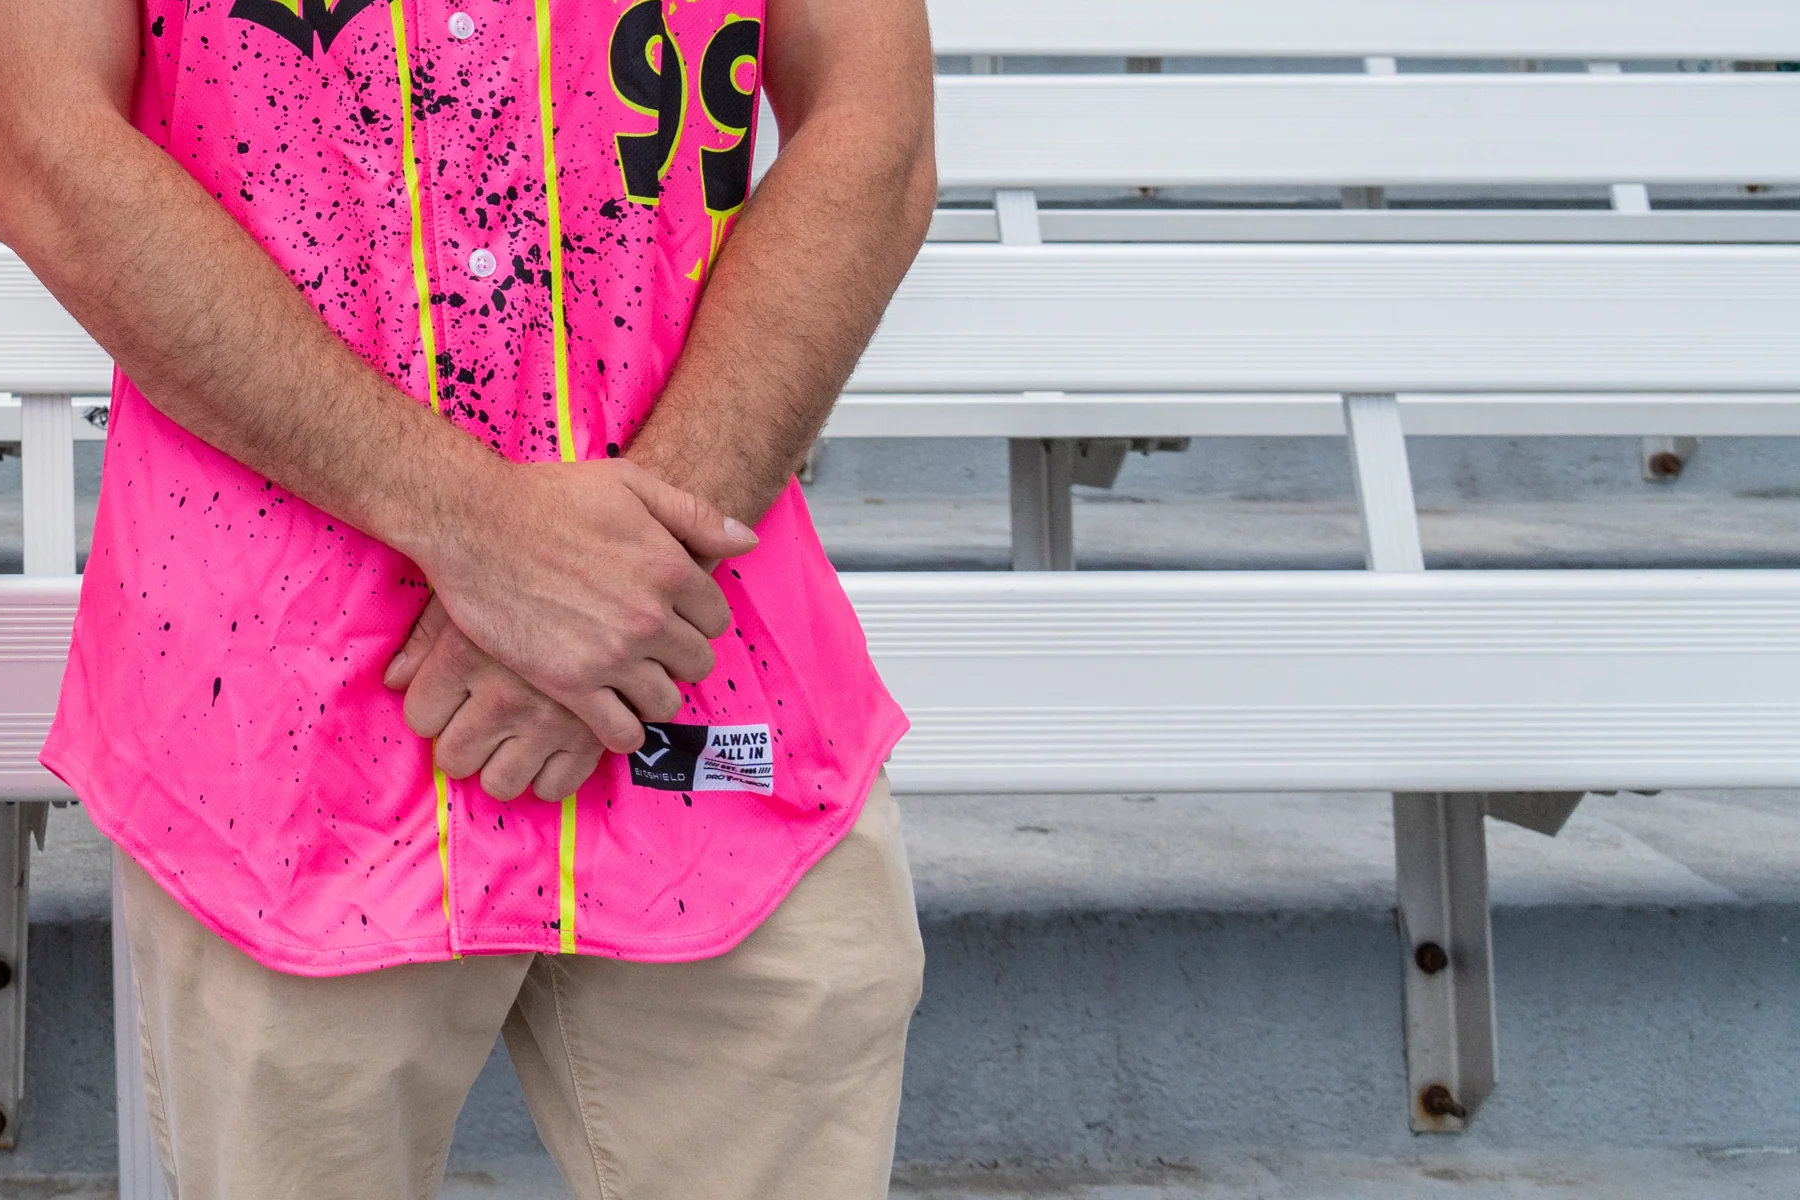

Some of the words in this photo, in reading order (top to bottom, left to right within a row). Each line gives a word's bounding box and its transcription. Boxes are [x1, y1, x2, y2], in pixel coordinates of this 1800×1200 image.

[711, 732, 768, 747] ALWAYS
[715, 748, 745, 760] ALL
[748, 746, 764, 760] IN
